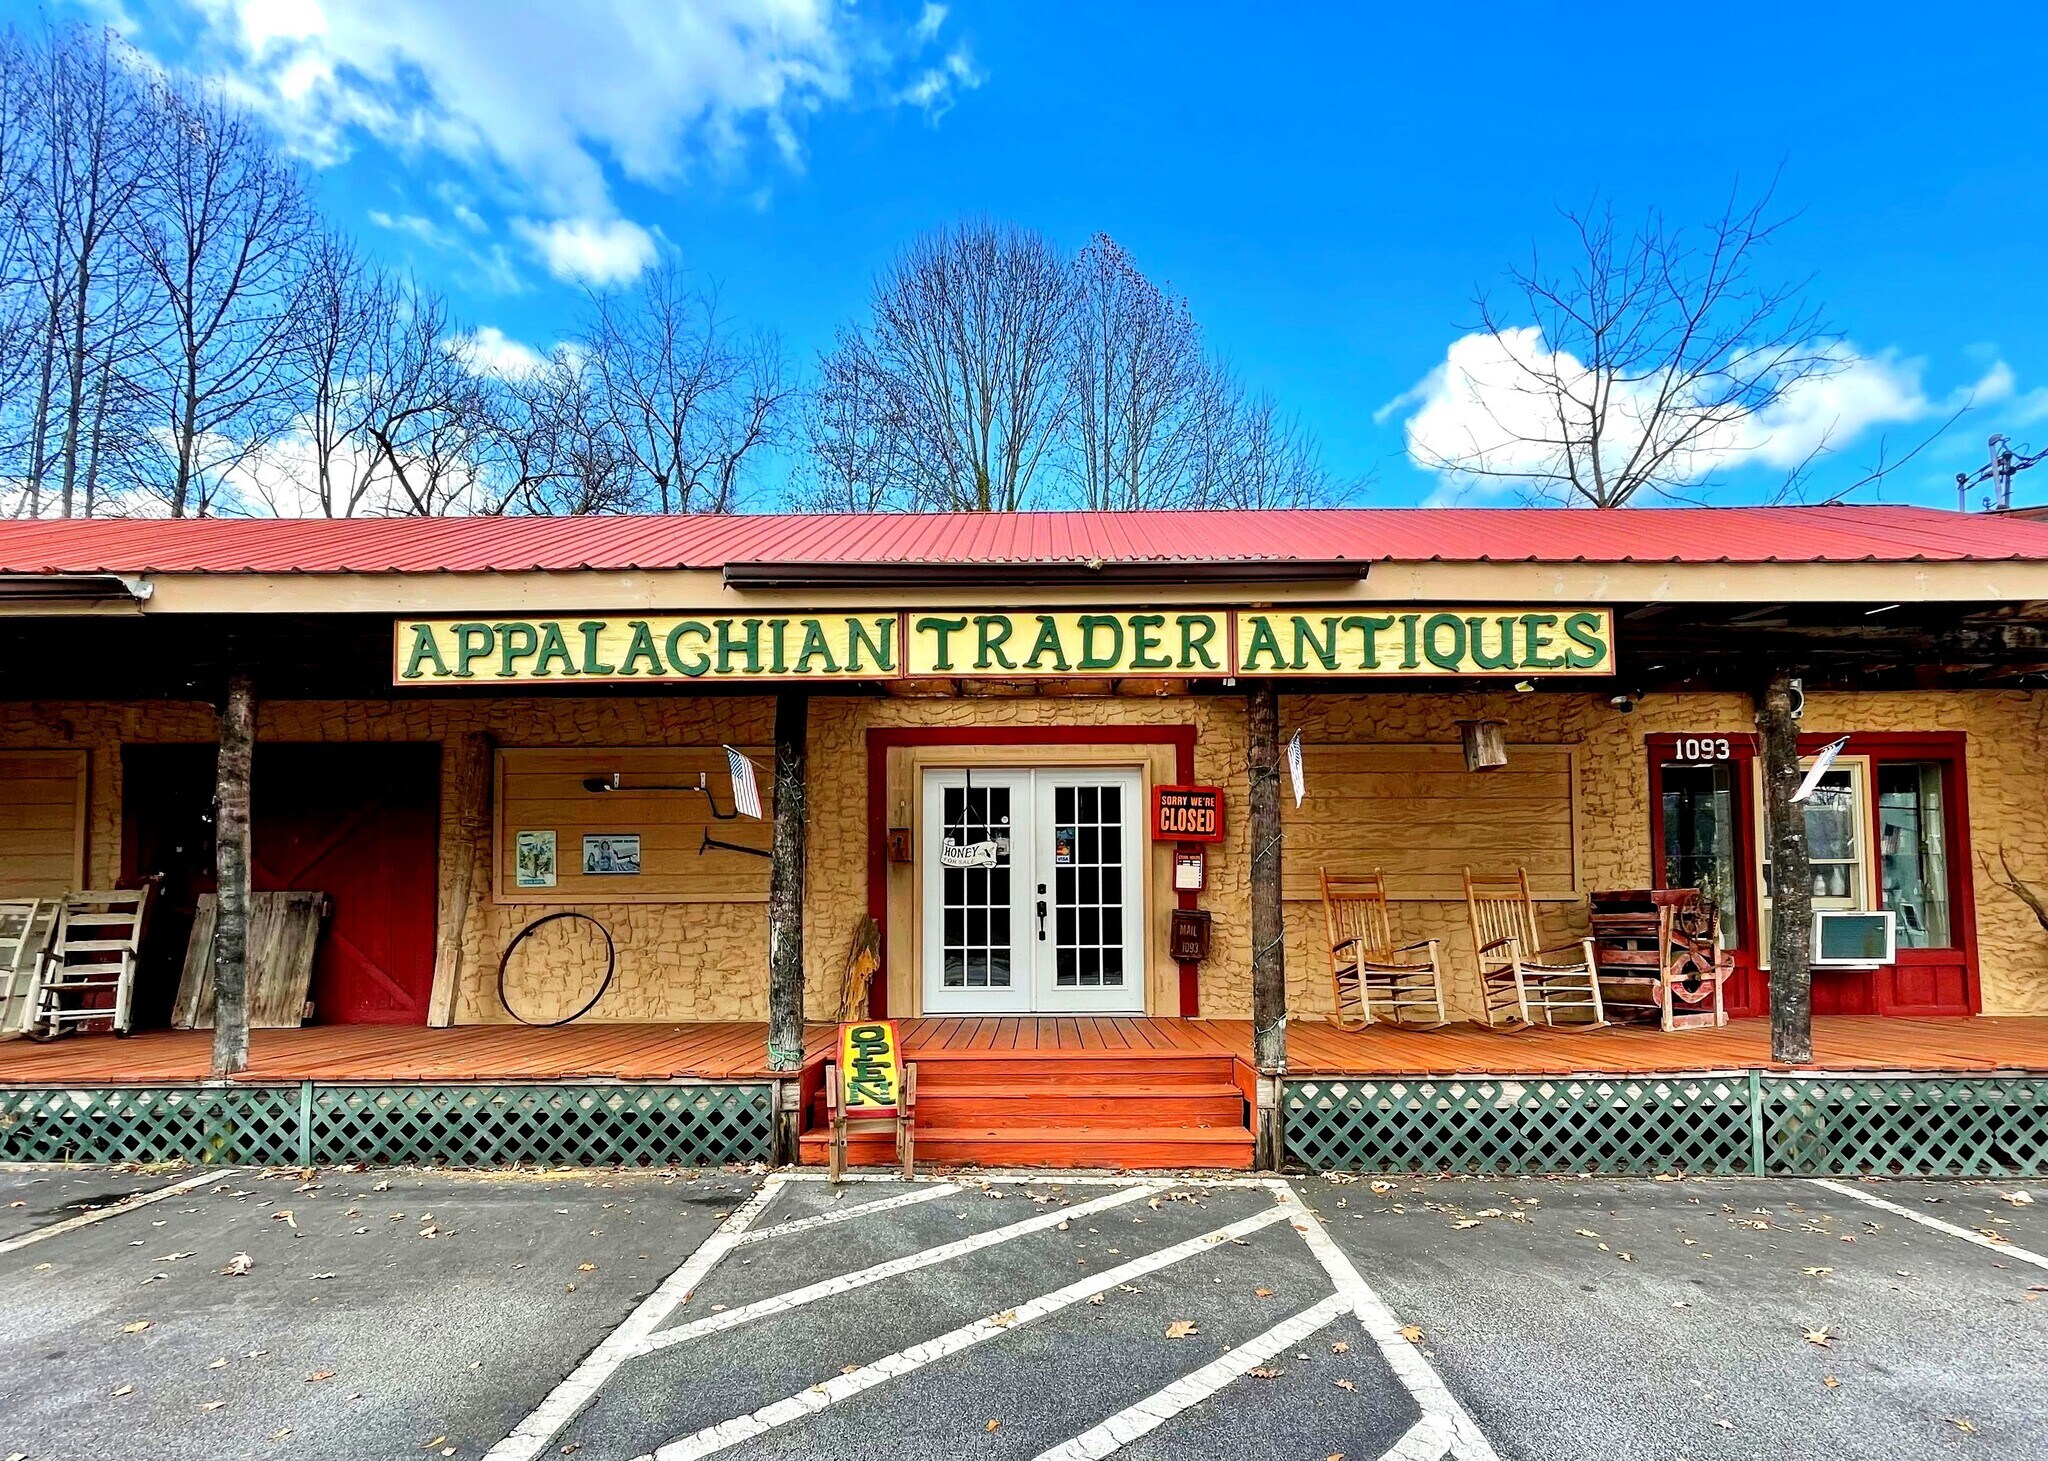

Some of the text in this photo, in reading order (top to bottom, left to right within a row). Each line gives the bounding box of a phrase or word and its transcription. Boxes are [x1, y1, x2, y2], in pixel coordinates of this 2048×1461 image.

[401, 612, 1608, 679] APPALACHIAN TRADER ANTIQUES
[1675, 738, 1730, 760] 1093
[1161, 795, 1215, 807] SORRY WE'RE
[1160, 807, 1215, 832] CLOSED
[944, 845, 980, 858] HONEY
[1179, 924, 1198, 937] MAIL
[1181, 941, 1199, 954] 1093
[846, 1025, 896, 1106] OPEN
